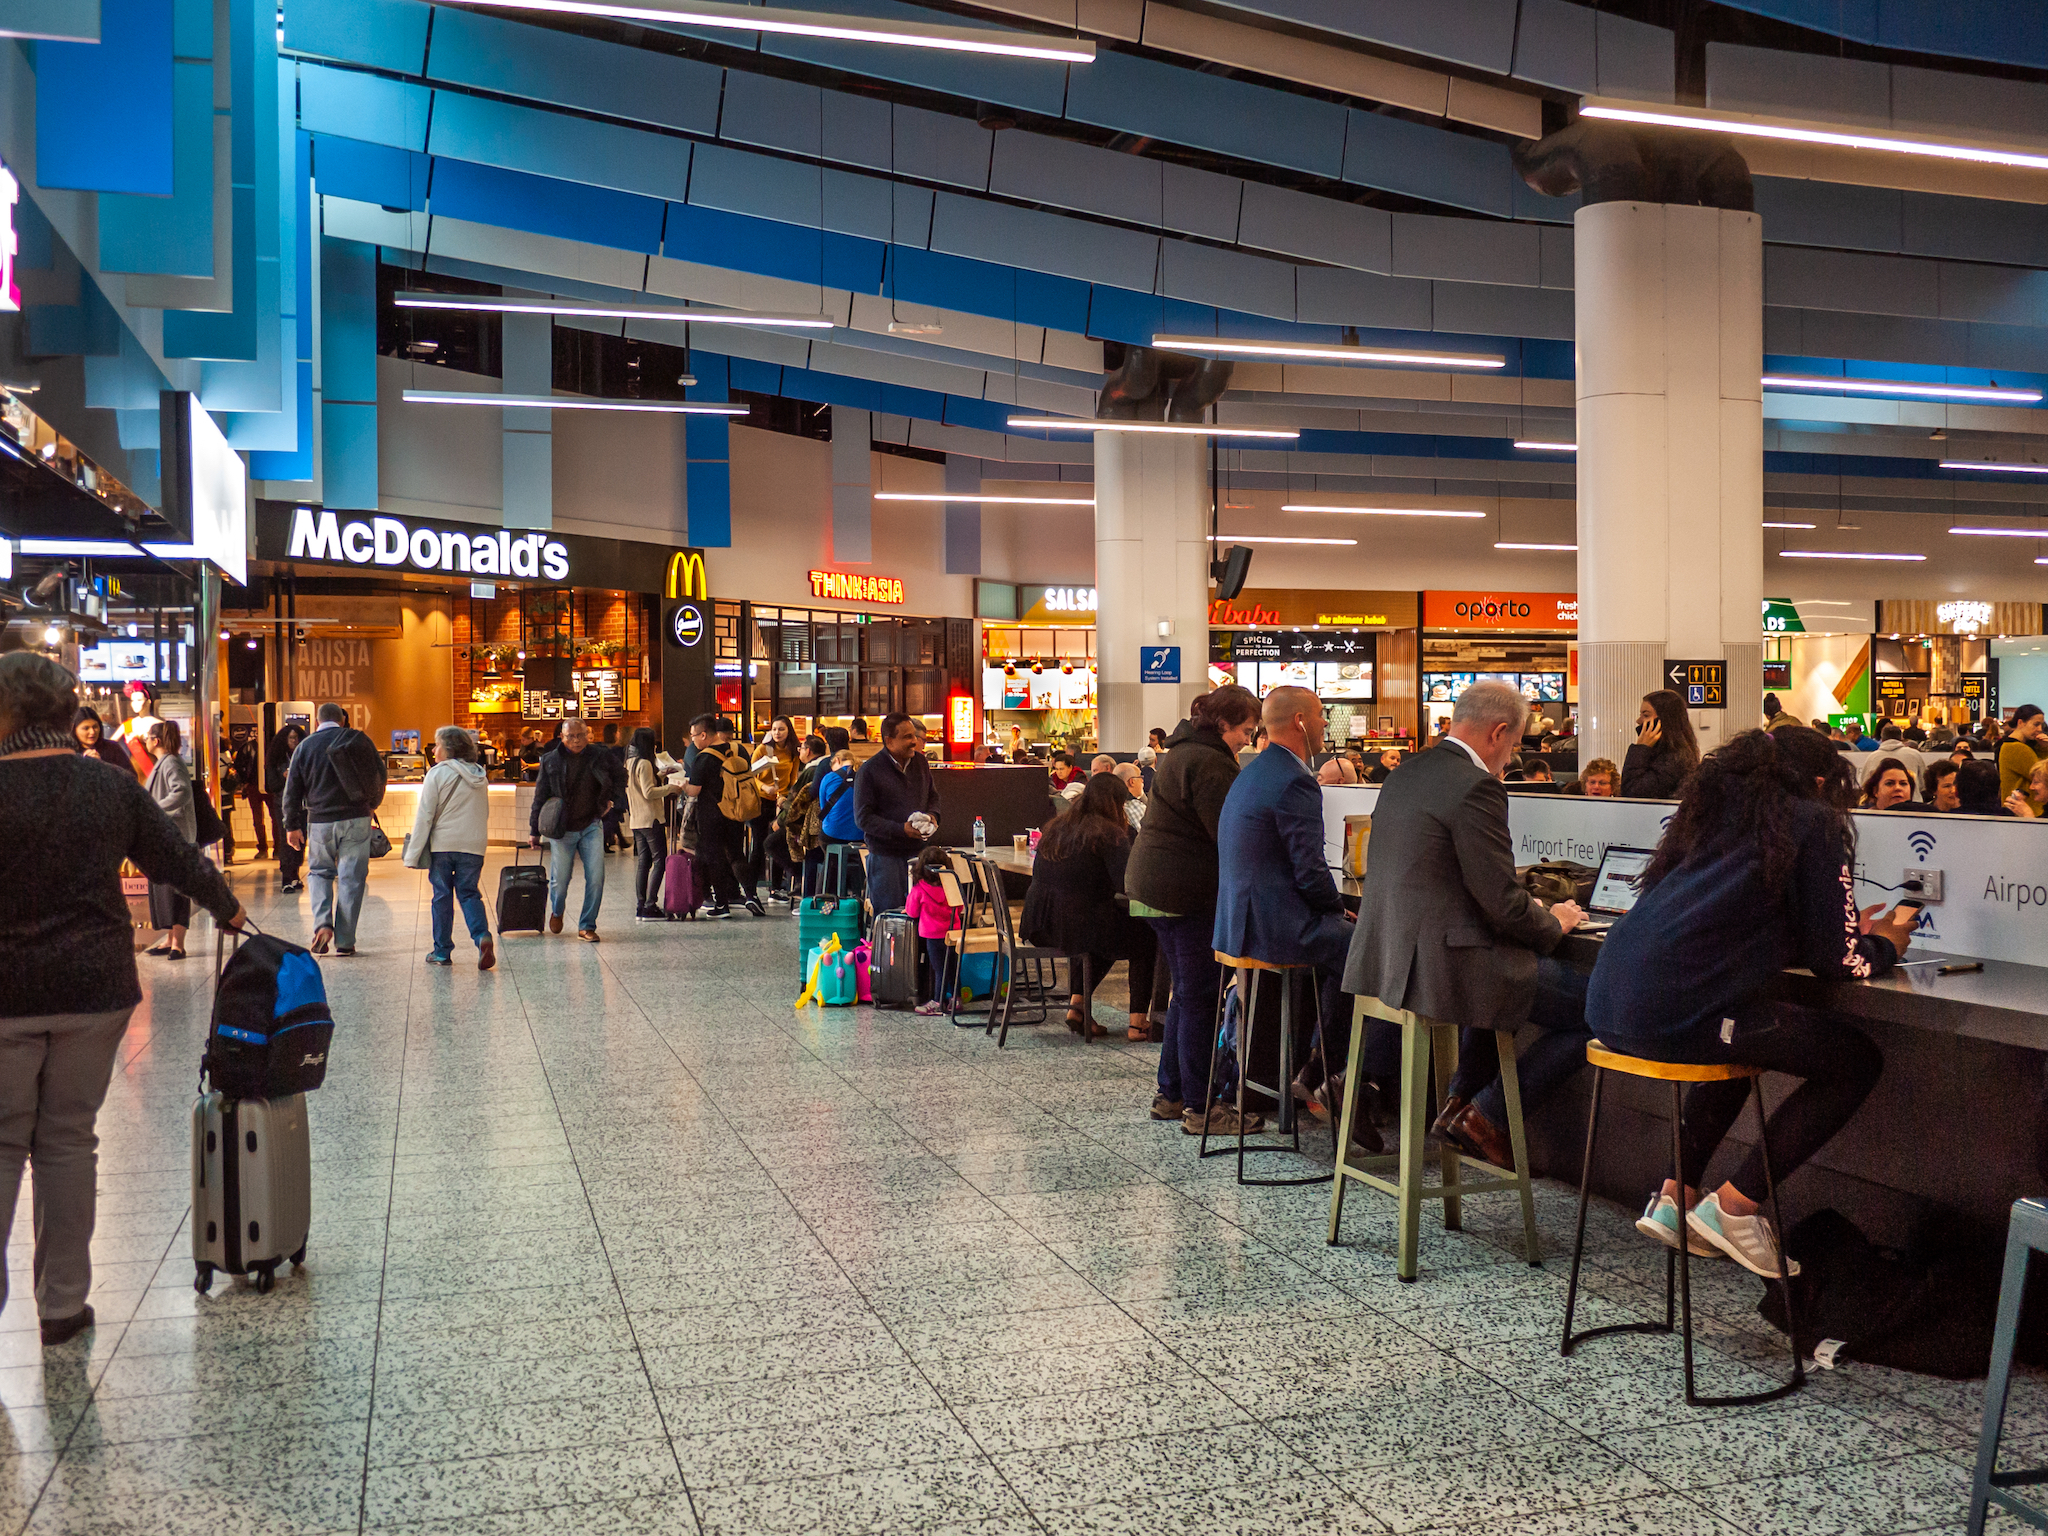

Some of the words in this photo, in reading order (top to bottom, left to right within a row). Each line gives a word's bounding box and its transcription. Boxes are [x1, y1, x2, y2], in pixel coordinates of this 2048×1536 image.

[287, 508, 570, 580] McDonald's
[809, 570, 863, 600] THINK
[867, 576, 904, 603] ASIA
[1223, 602, 1281, 625] baba
[1454, 599, 1530, 621] oporto
[284, 639, 370, 667] ARISTA
[1243, 636, 1273, 645] SPICED
[298, 669, 356, 697] MADE
[1963, 685, 1980, 693] COFFEE
[1521, 834, 1563, 859] Airport
[1567, 838, 1594, 860] Free
